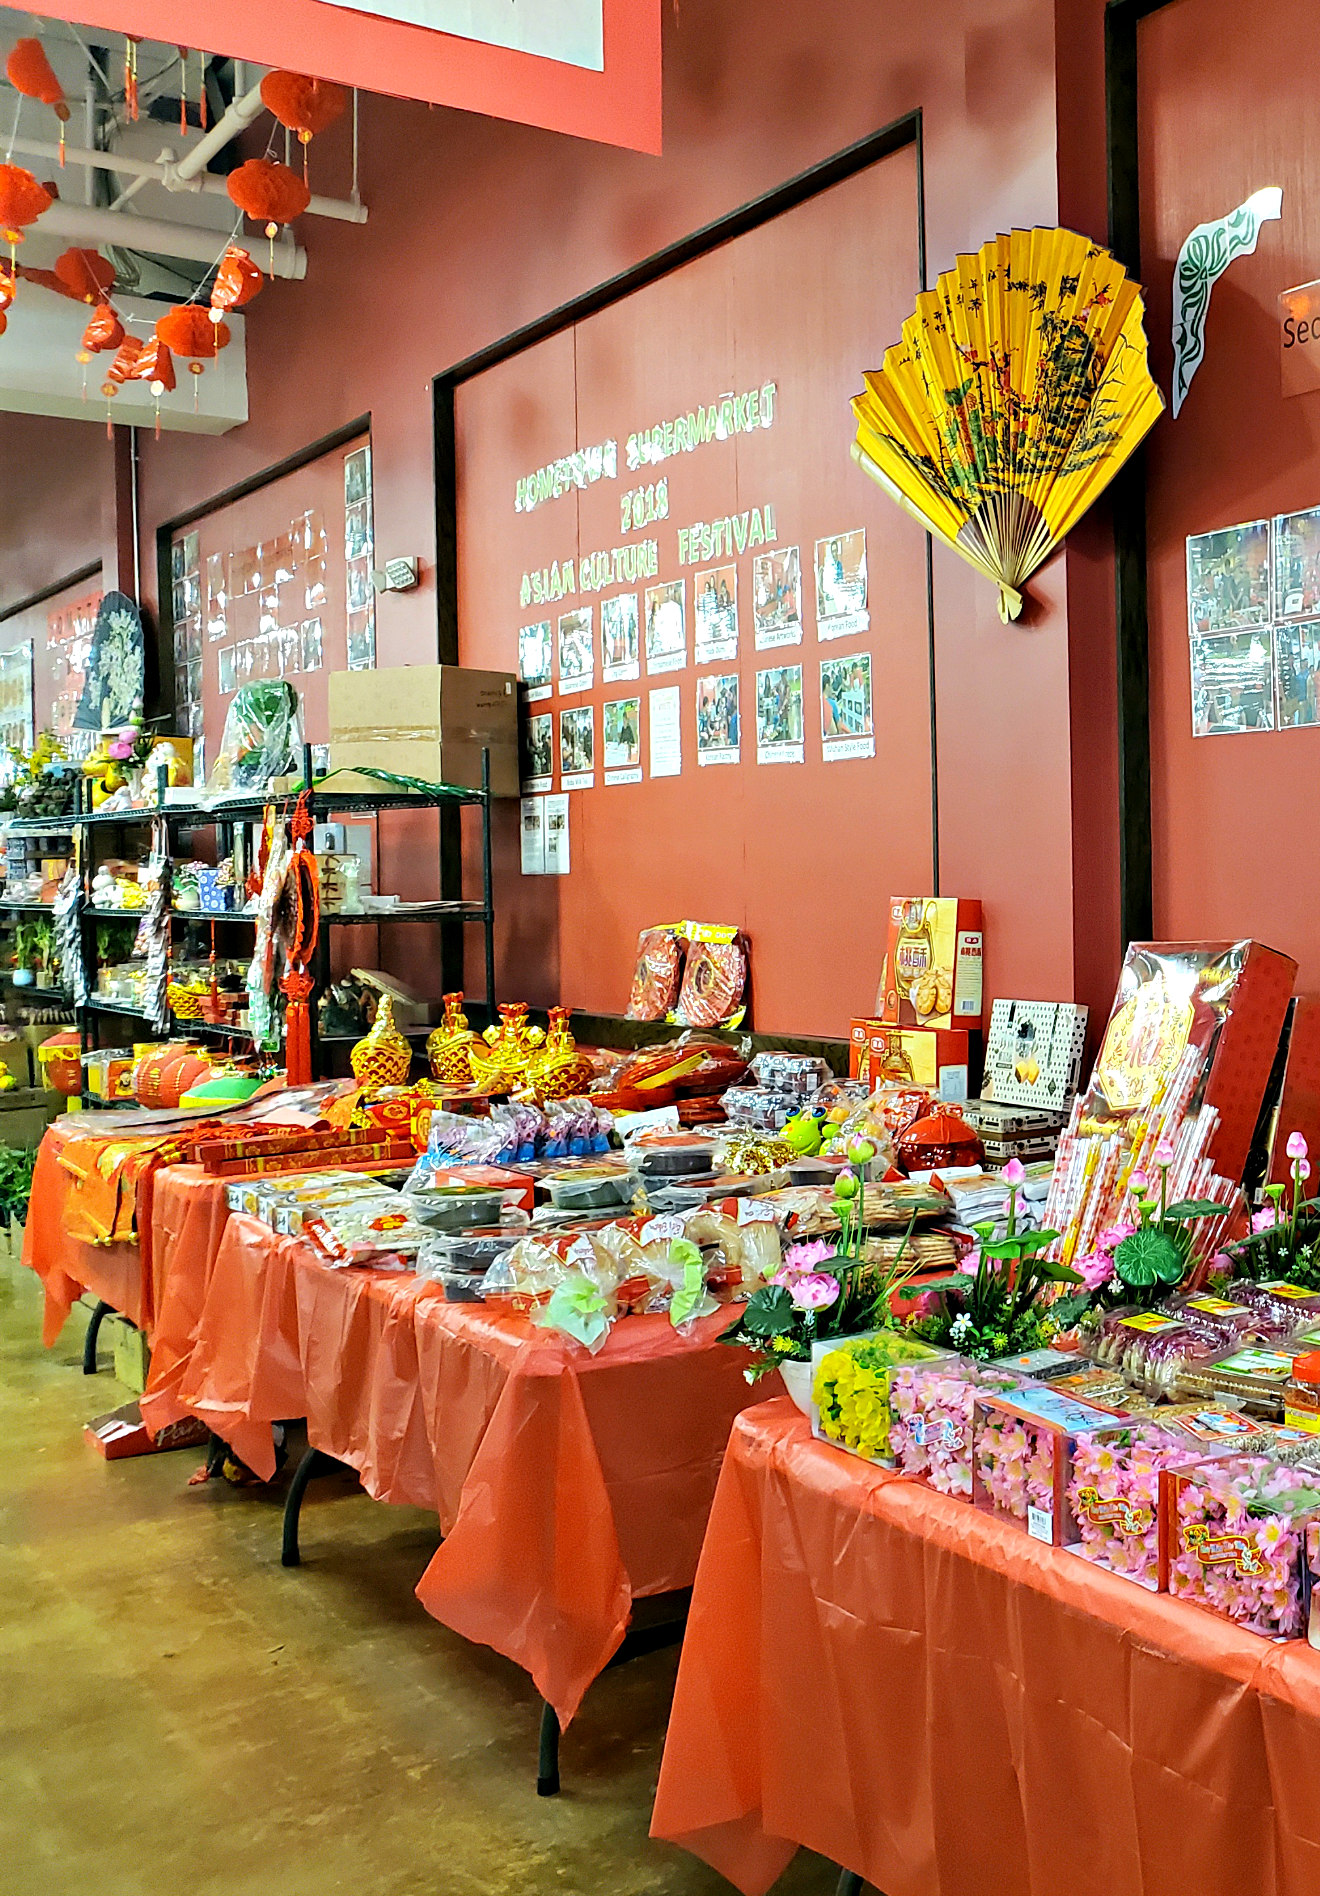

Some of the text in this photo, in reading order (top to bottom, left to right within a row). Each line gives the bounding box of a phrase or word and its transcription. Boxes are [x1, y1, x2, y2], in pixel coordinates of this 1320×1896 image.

[514, 381, 778, 513] HOMETOWN SUPERMARKET
[518, 503, 778, 609] ASIAN CULTURE FESTIVAL
[619, 476, 670, 534] 2018
